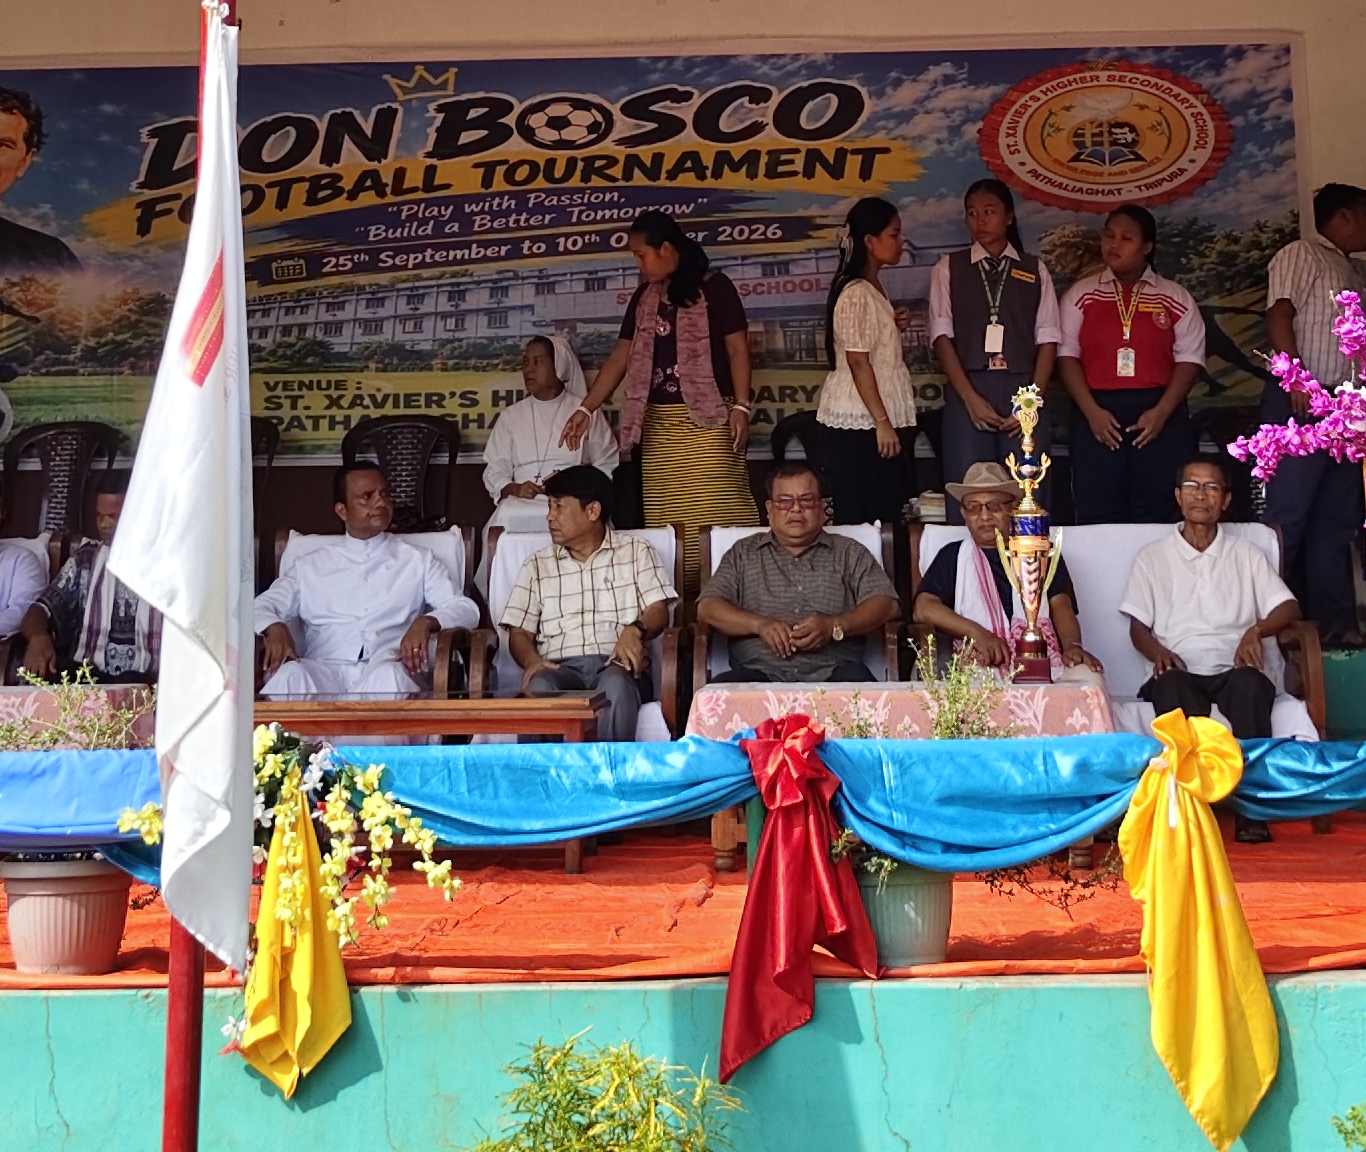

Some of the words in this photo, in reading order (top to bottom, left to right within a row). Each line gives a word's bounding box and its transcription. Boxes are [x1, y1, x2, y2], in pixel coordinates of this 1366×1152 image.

[1039, 74, 1100, 96] HIGHER
[1106, 74, 1198, 111] SECONDARY
[1192, 110, 1210, 152] SCHOOL
[134, 105, 399, 191] DON
[423, 81, 866, 160] BOSCO
[473, 146, 891, 190] TOURNAMENT
[1137, 166, 1189, 193] TRIPURA
[464, 194, 516, 214] with
[527, 190, 625, 208] Passion,
[444, 222, 460, 234] a
[472, 211, 556, 232] Better
[321, 252, 370, 273] 25th
[378, 241, 512, 269] September
[521, 238, 547, 255] to
[555, 233, 601, 253] 10th
[716, 223, 783, 242] 2026
[739, 276, 829, 297] SCHOOL
[263, 379, 348, 392] VENUE
[263, 394, 312, 411] ST.
[323, 390, 480, 410] XAVIER'S
